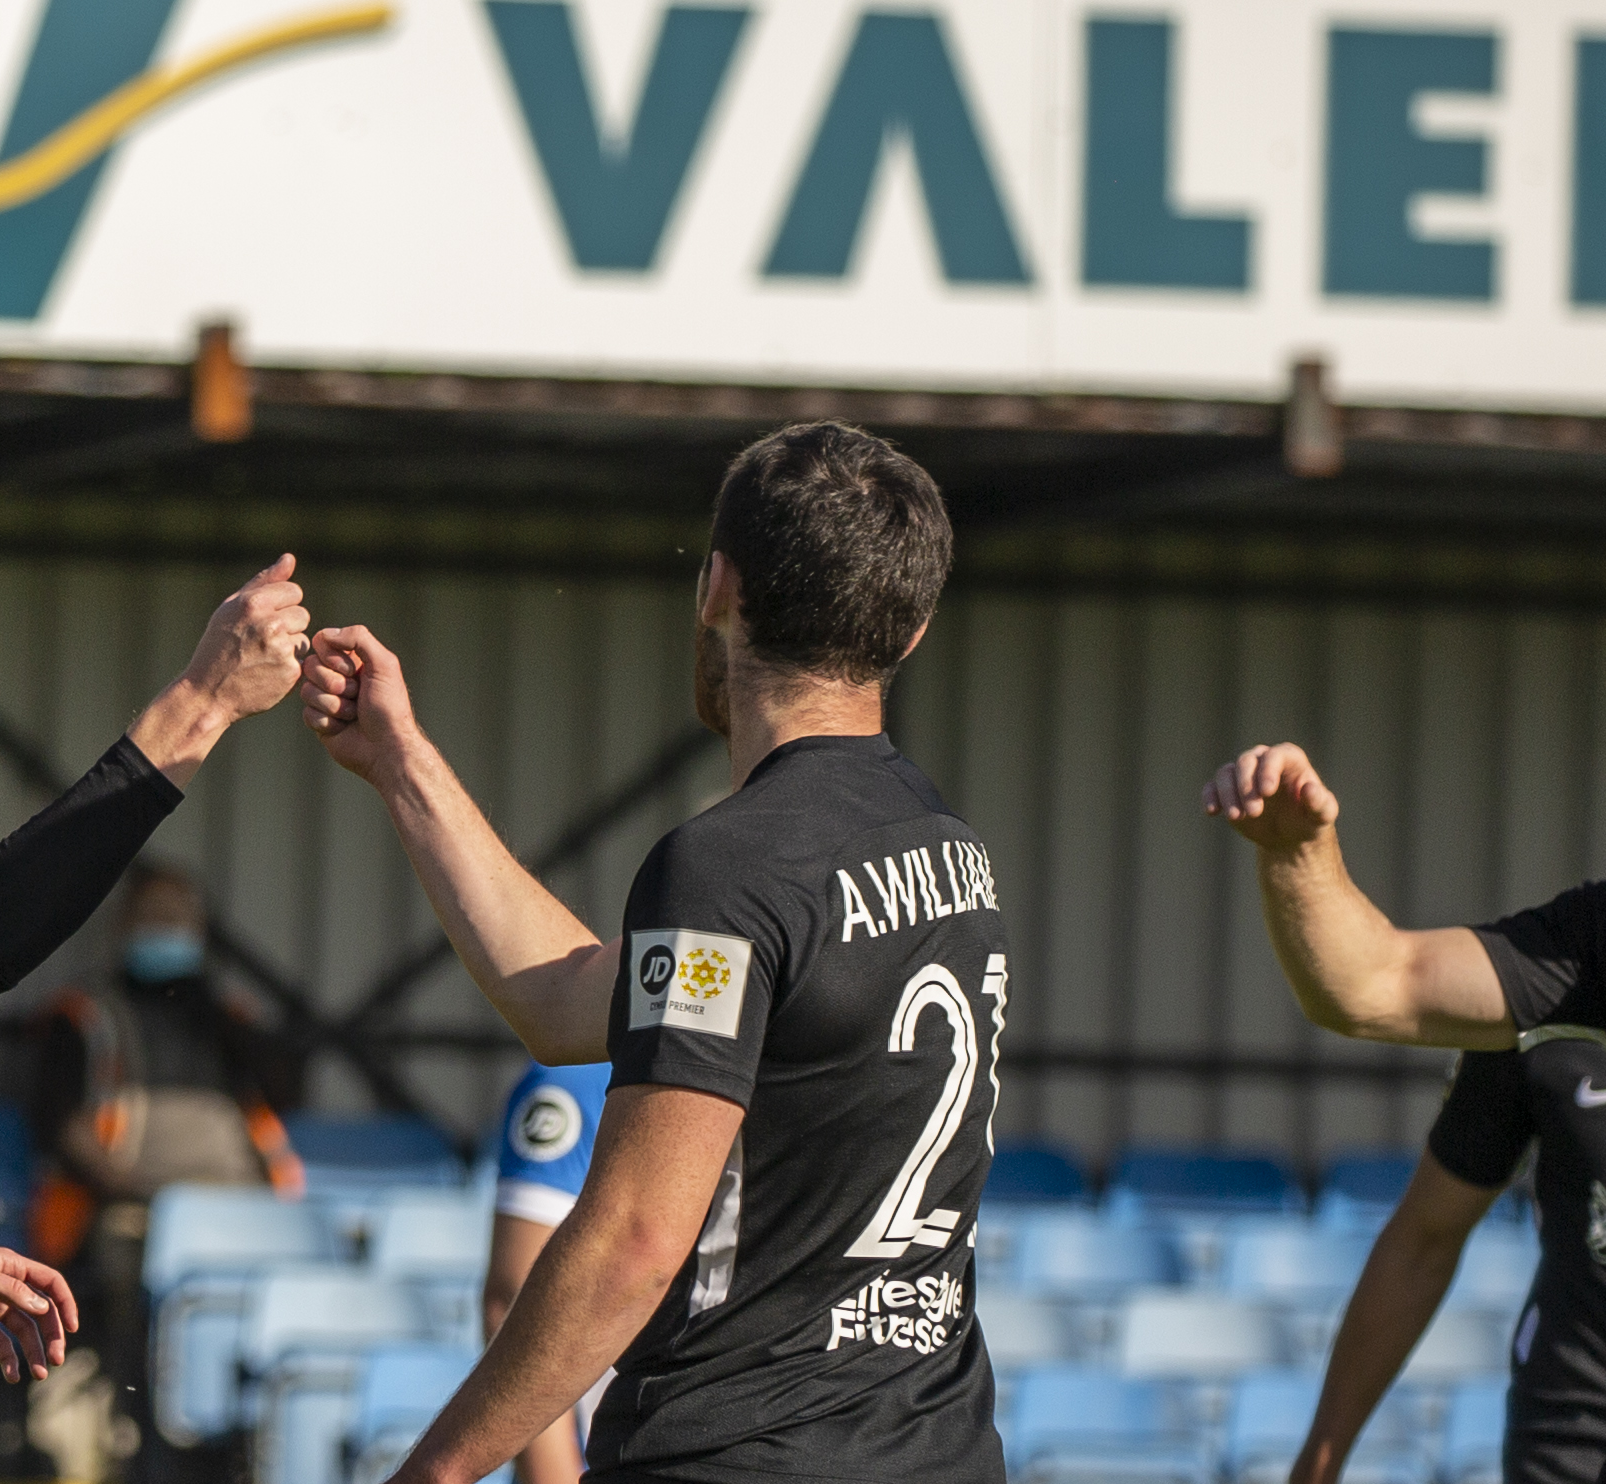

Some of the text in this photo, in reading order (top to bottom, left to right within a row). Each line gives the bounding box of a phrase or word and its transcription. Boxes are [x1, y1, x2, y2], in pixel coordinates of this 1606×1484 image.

[481, 0, 1606, 306] VALE
[643, 956, 672, 984] JD
[668, 1000, 705, 1015] PREMIER
